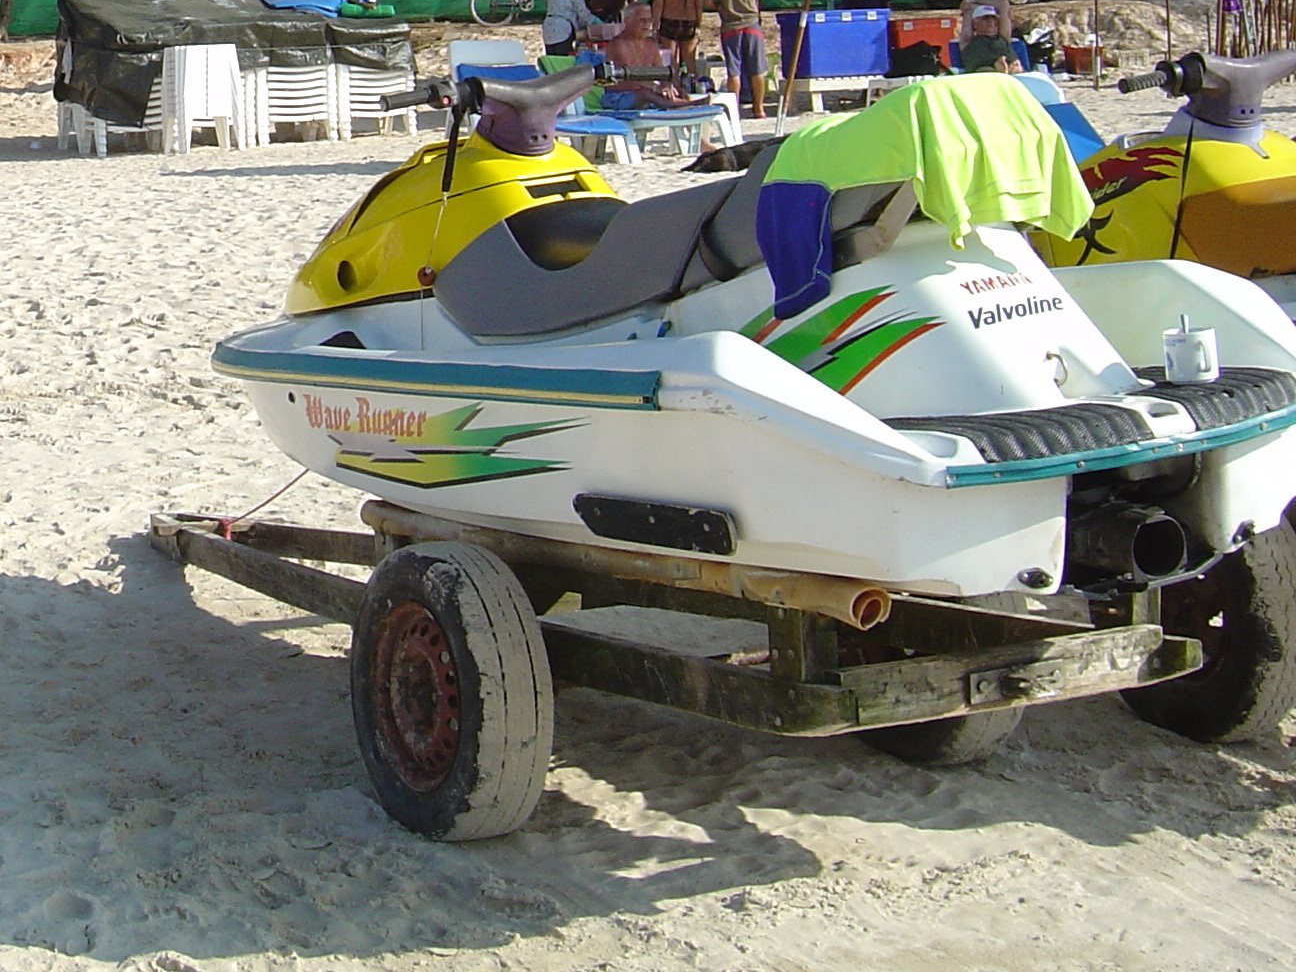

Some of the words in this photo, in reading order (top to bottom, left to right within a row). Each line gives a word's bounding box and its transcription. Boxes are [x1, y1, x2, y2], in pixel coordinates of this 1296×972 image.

[960, 272, 1033, 295] YAMAHA
[967, 295, 1064, 329] Valvoline
[302, 393, 351, 432] Wave
[355, 395, 427, 438] Runner
